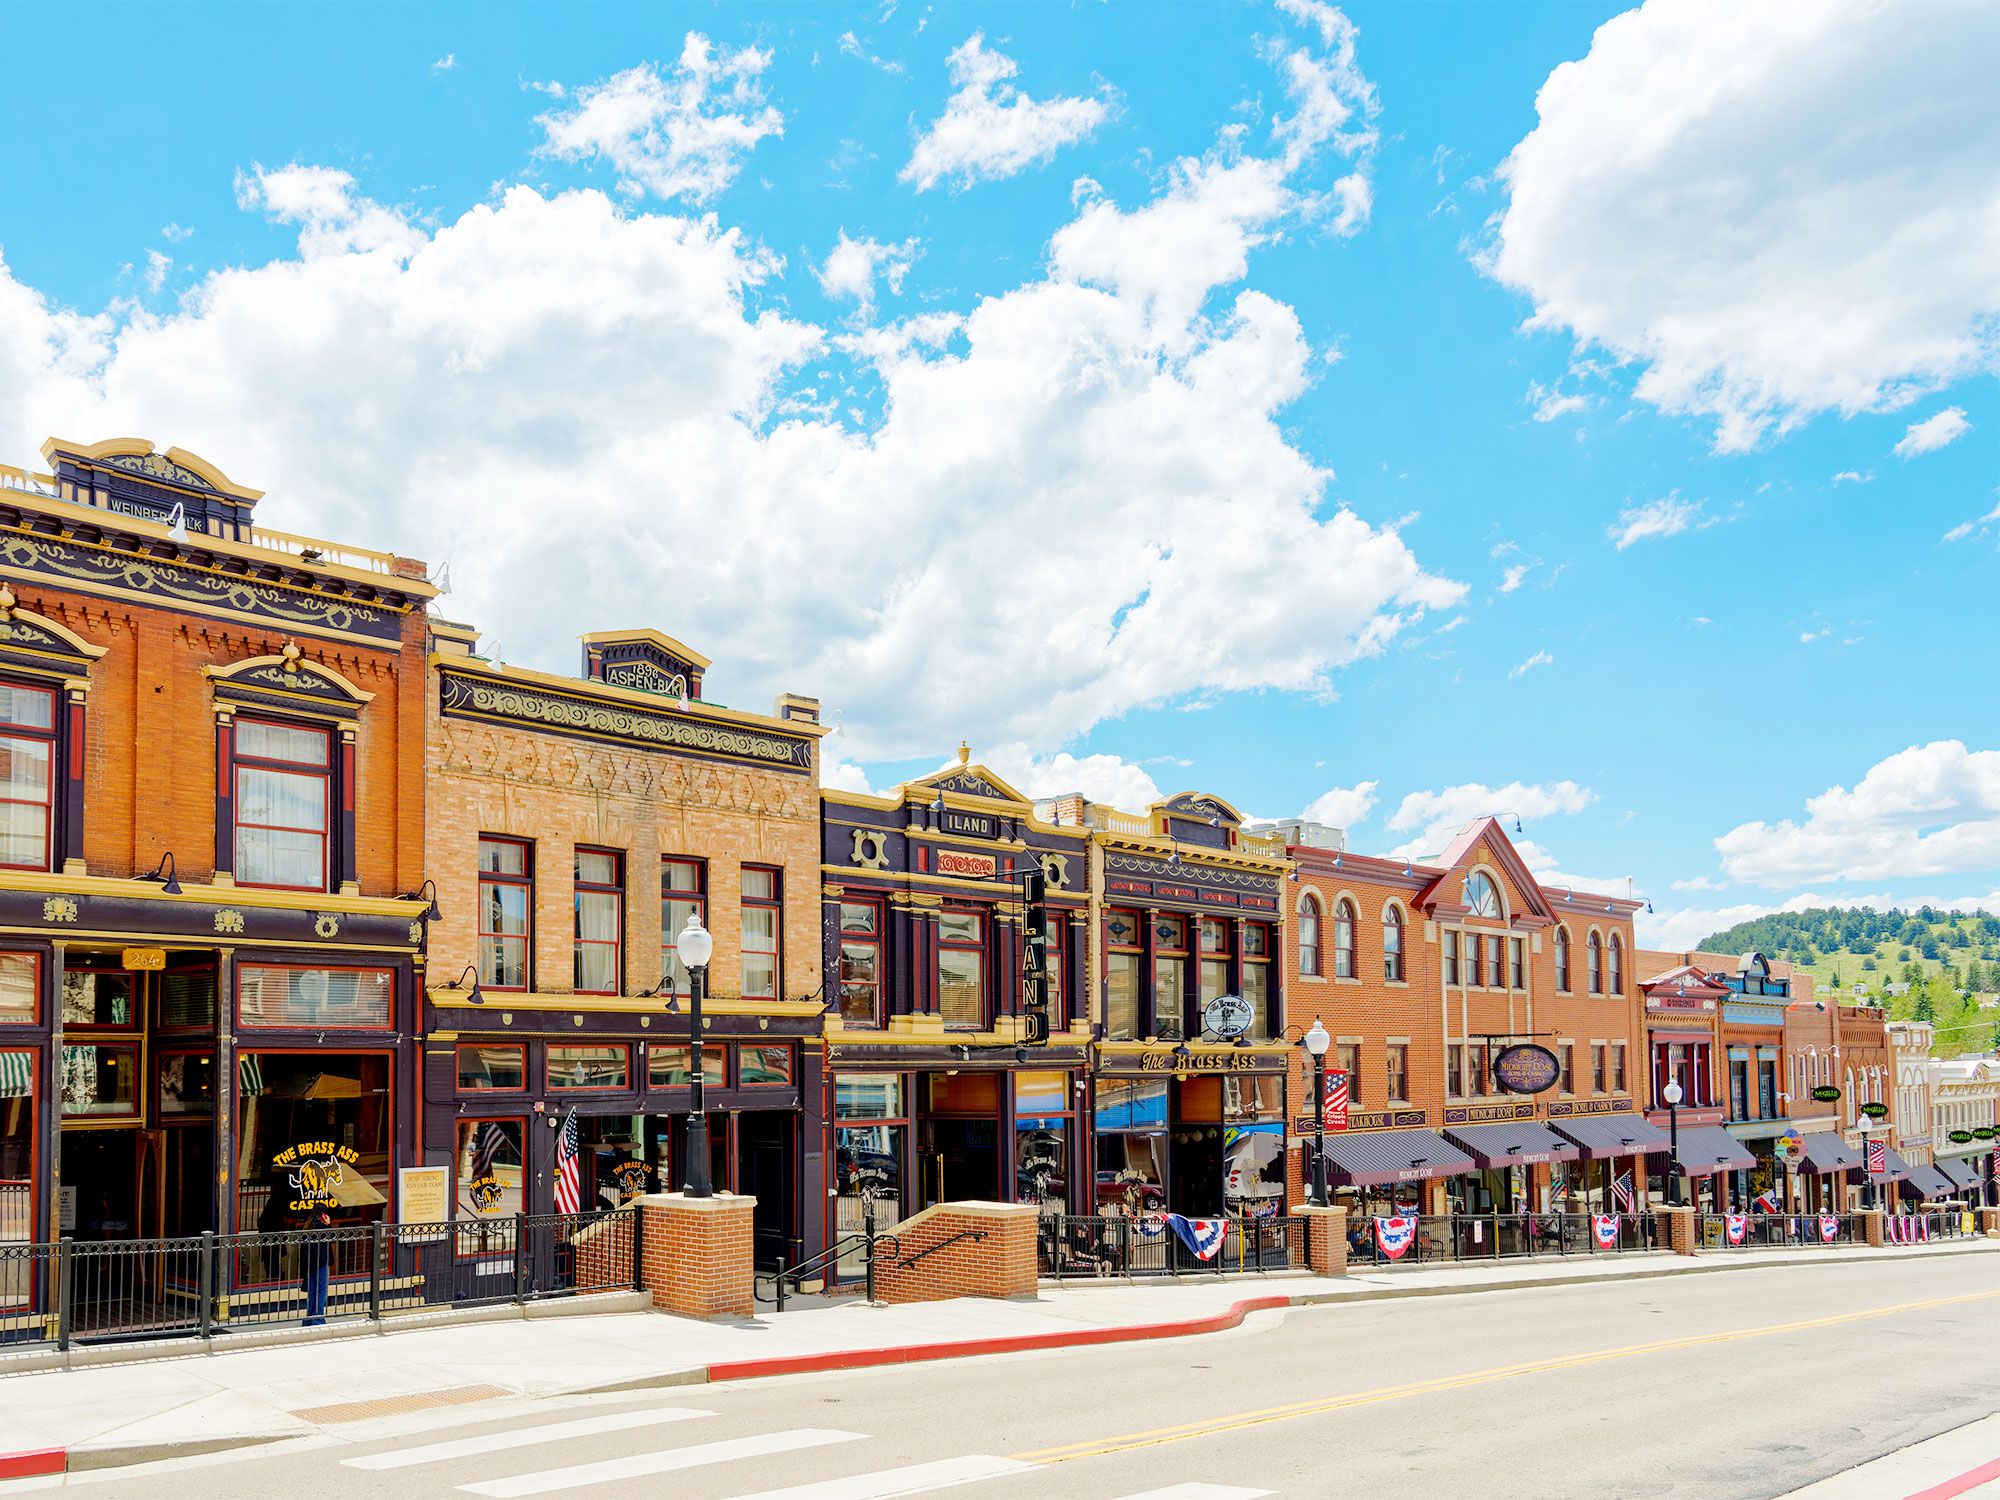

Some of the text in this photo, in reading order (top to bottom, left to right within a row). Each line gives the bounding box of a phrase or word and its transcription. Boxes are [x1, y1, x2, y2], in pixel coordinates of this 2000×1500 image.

[111, 500, 176, 525] WEINBERG
[609, 669, 652, 691] ASPEN
[633, 663, 659, 679] 1896
[949, 815, 988, 833] ILAND
[131, 952, 157, 966] 264
[1022, 875, 1038, 1041] ILAND
[1142, 1051, 1257, 1072] The Brass Ass
[1349, 1114, 1385, 1128] TEAKHOUSE
[273, 1141, 360, 1167] THE BRASS ASS
[289, 1198, 338, 1211] CASNO
